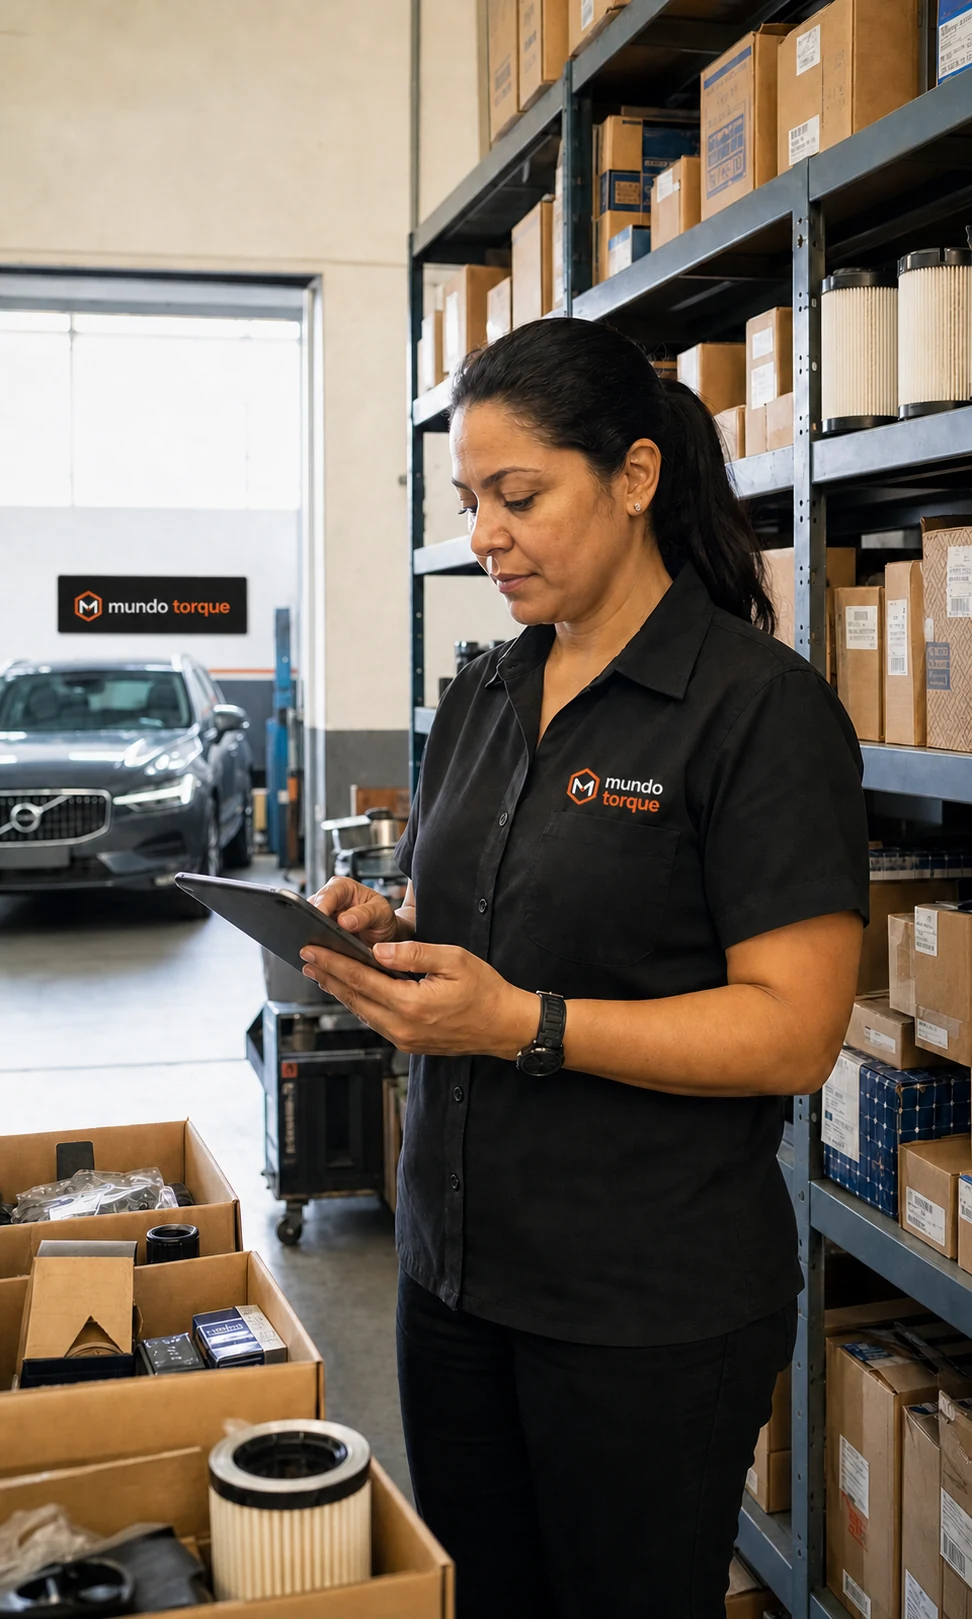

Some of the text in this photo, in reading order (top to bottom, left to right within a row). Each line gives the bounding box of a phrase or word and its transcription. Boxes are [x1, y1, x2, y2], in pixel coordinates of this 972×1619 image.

[108, 598, 230, 617] mundo torque
[604, 777, 664, 795] mundo
[602, 790, 660, 813] torque
